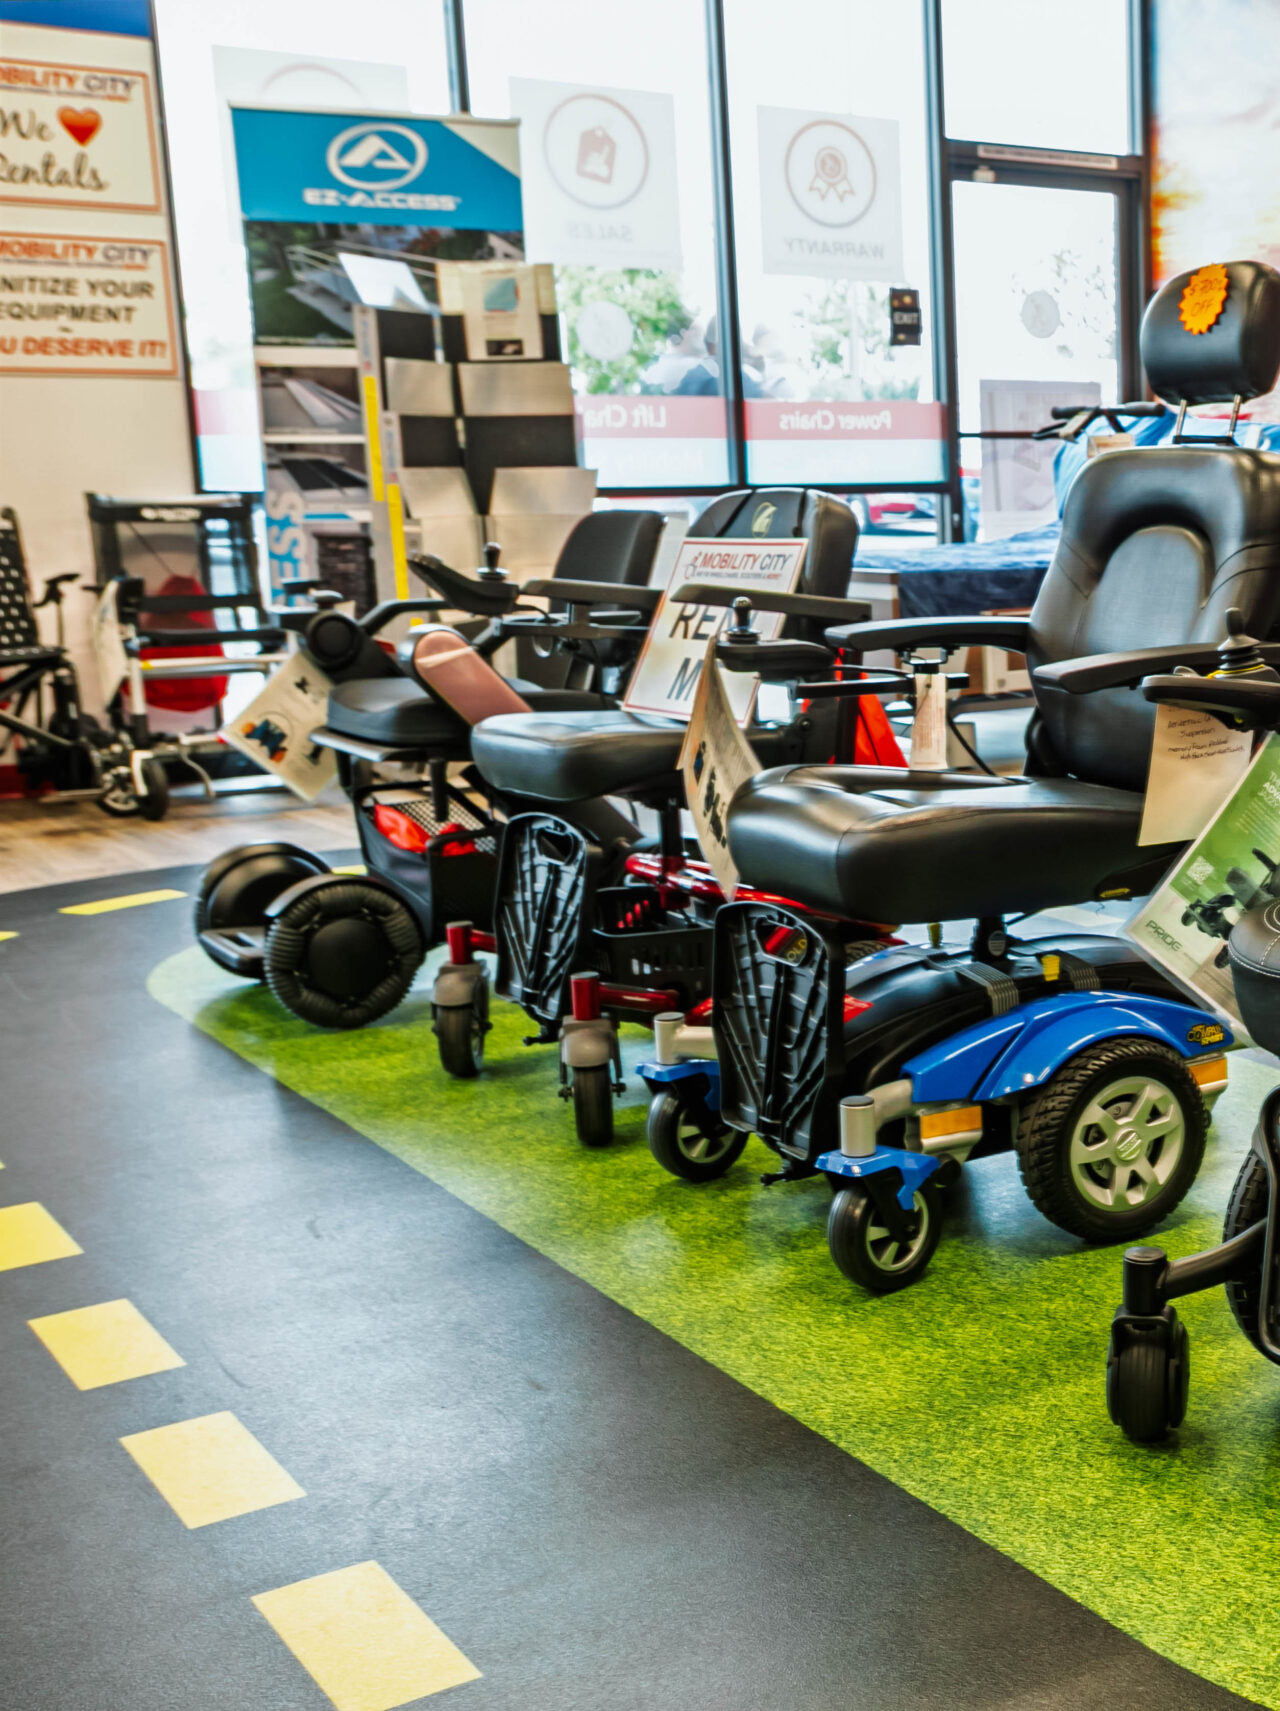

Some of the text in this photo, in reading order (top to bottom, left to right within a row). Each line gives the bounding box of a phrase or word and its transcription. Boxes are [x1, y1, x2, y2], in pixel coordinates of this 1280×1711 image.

[83, 73, 135, 93] CITY
[302, 187, 456, 212] EZ-ACCESS
[102, 244, 153, 262] CITY
[87, 279, 154, 299] YOUR
[21, 336, 134, 358] DESERVE
[138, 340, 167, 359] IT!
[700, 552, 793, 572] MOBILITY CITY
[1145, 920, 1183, 952] PRIDE
